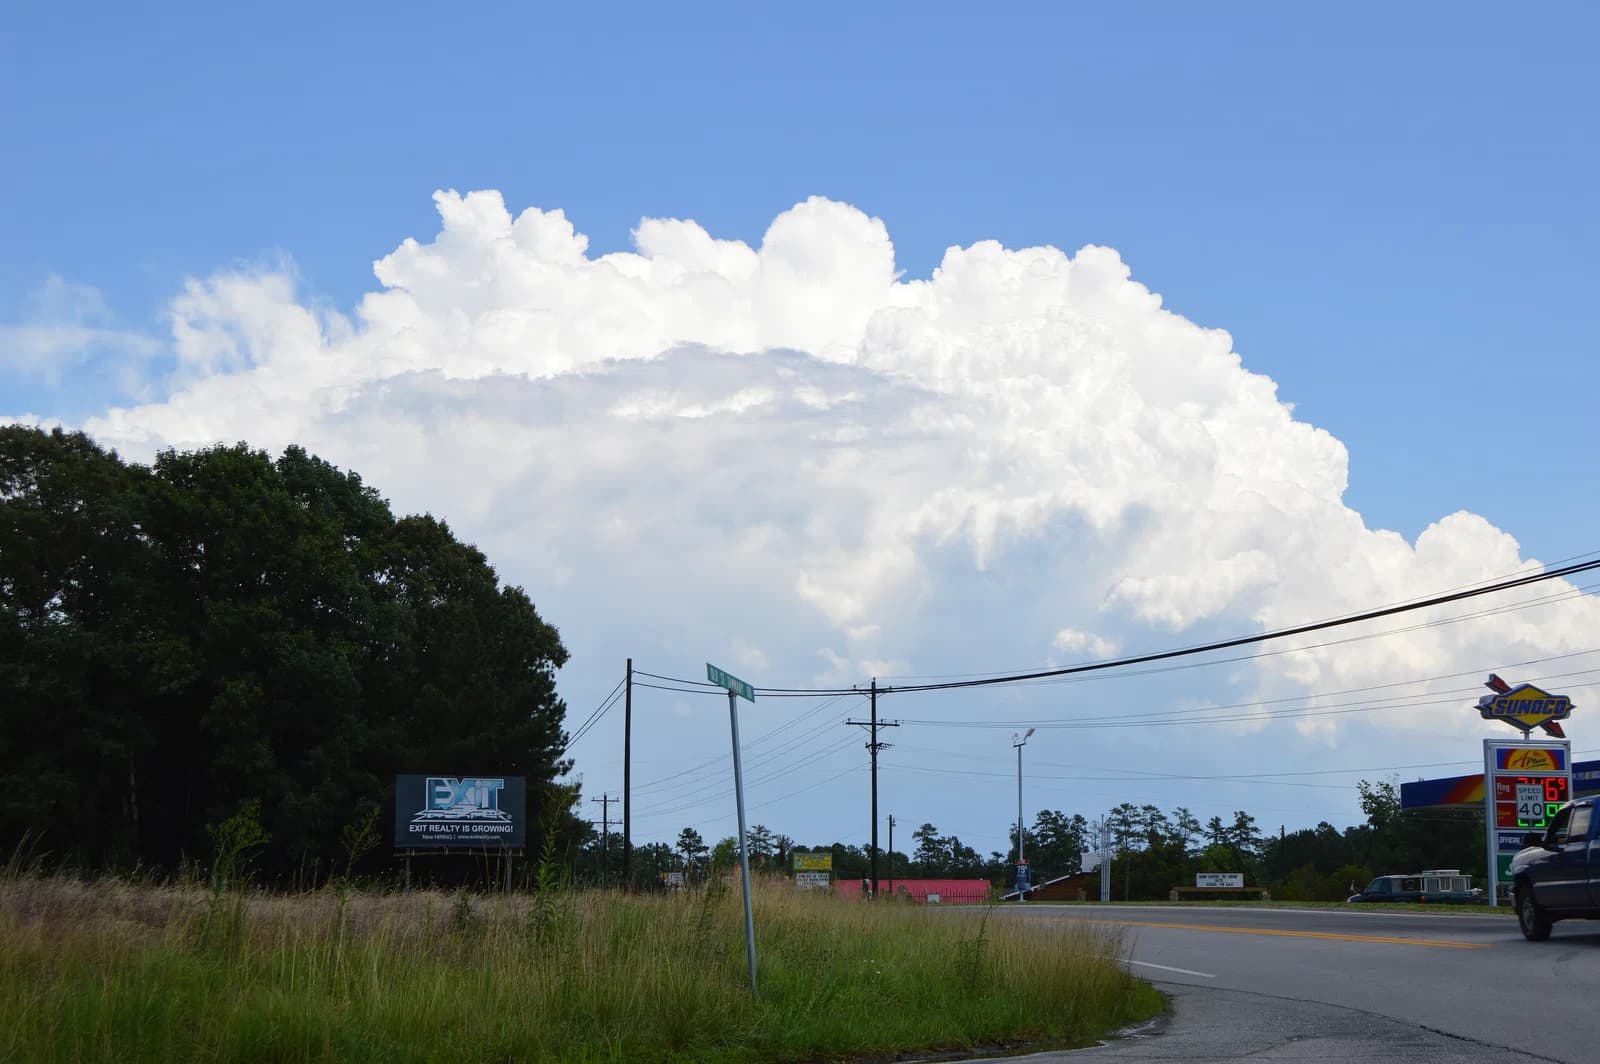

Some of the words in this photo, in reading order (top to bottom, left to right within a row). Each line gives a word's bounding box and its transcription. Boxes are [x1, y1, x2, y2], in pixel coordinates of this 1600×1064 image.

[1495, 699, 1567, 715] SUNOCO
[1519, 803, 1542, 816] 40
[409, 824, 427, 832] EXIT
[429, 824, 460, 832] REALTY
[471, 825, 513, 833] GROWING!
